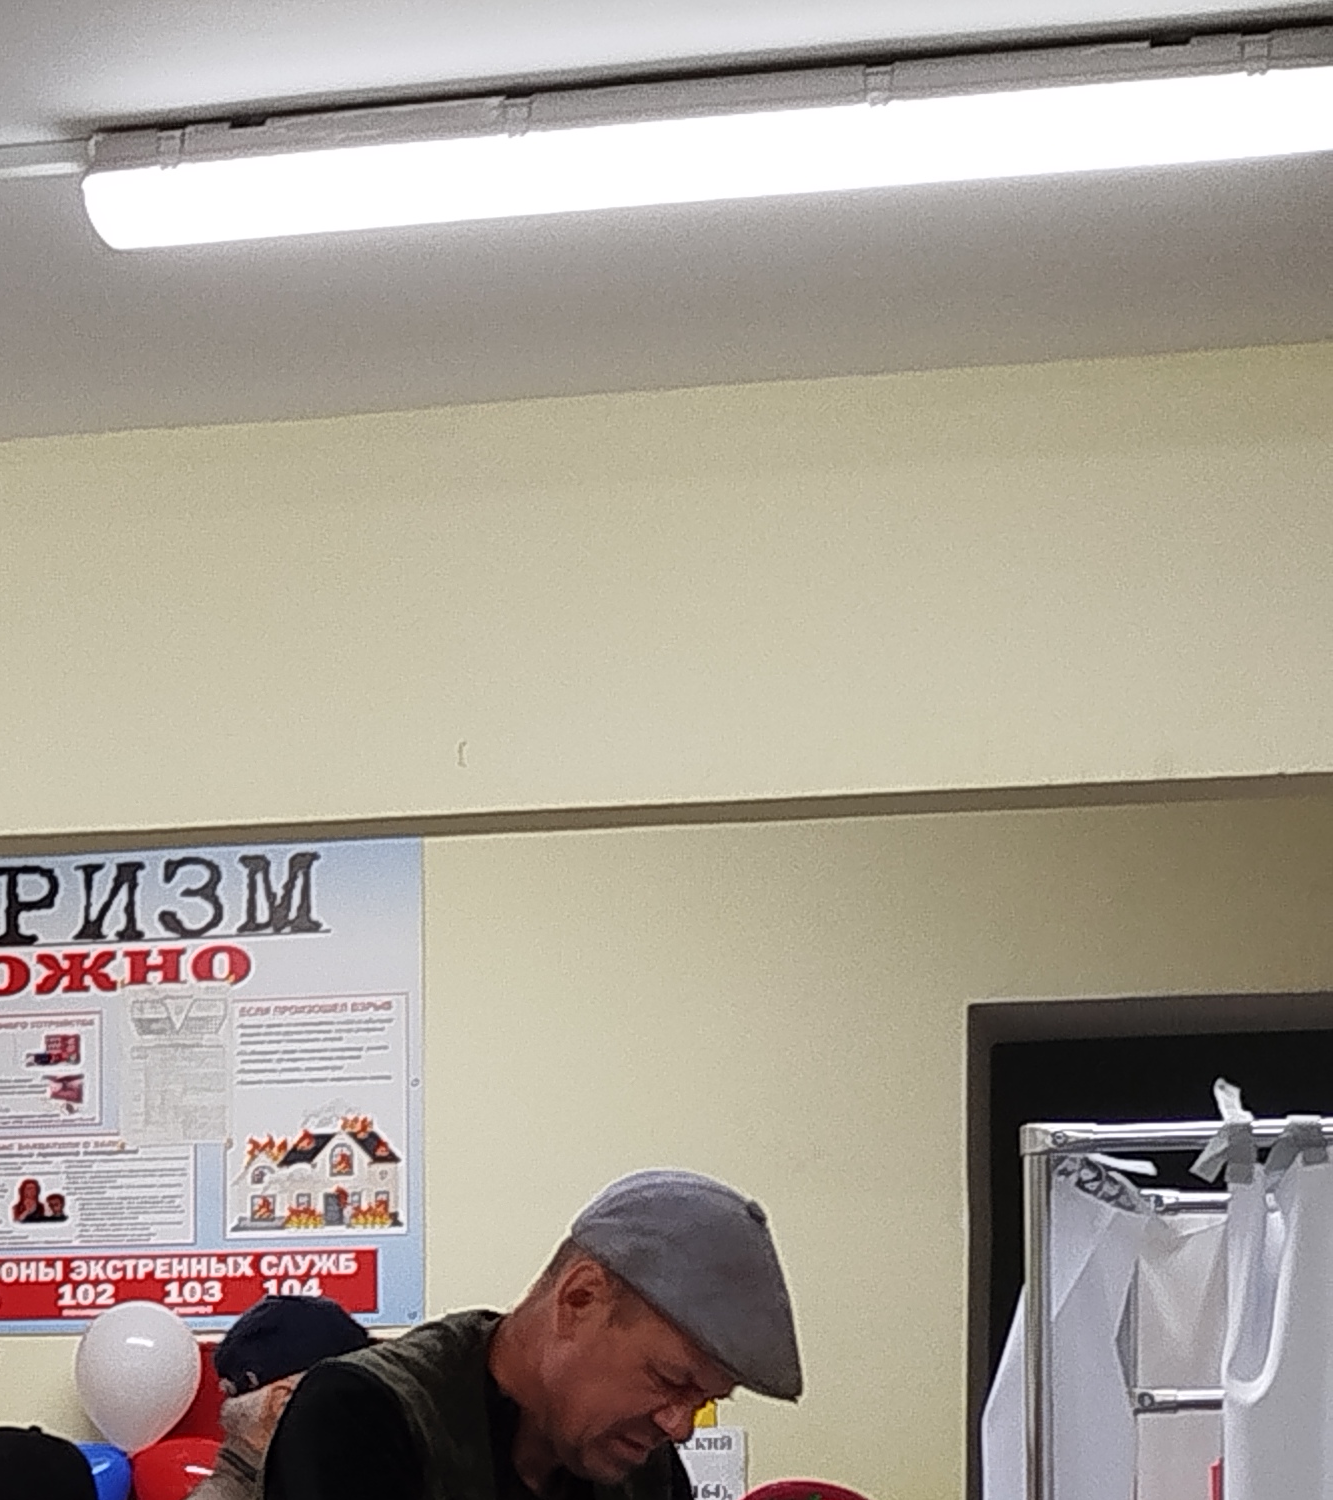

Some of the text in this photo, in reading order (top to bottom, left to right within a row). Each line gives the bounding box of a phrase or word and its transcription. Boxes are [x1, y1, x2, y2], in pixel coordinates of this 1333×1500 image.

[69, 1256, 254, 1281] ЭКСТРЕННЫХ
[259, 1252, 359, 1275] СЛУЖБ
[57, 1283, 117, 1307] 102
[163, 1281, 224, 1304] 103
[262, 1278, 323, 1299] 104
